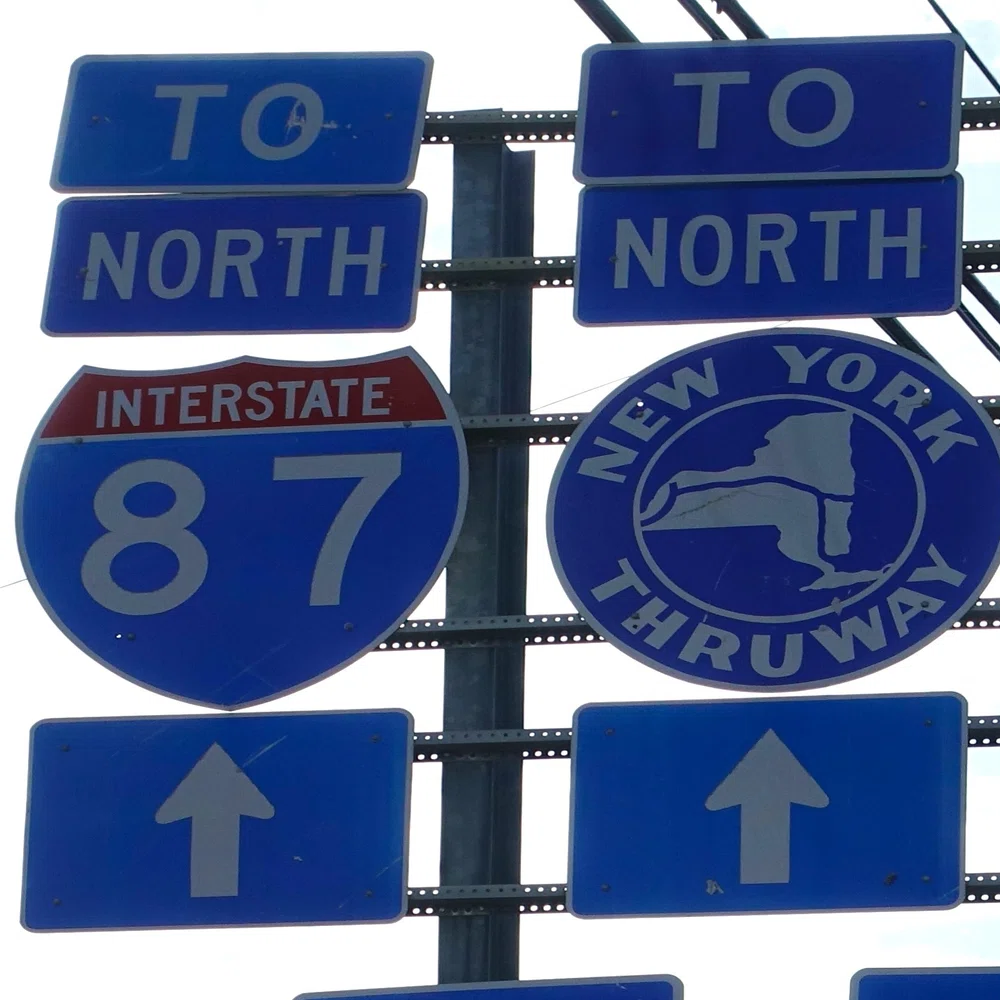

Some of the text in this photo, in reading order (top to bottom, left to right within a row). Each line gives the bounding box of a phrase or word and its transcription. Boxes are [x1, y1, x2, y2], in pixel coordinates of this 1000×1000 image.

[154, 83, 325, 161] TO
[674, 68, 855, 149] TO
[81, 226, 386, 301] NORTH
[613, 207, 922, 289] NORTH
[96, 376, 392, 429] INTERSTATE
[577, 345, 983, 484] NEW YORK
[81, 452, 402, 615] 87
[590, 544, 968, 677] THRUWAY
